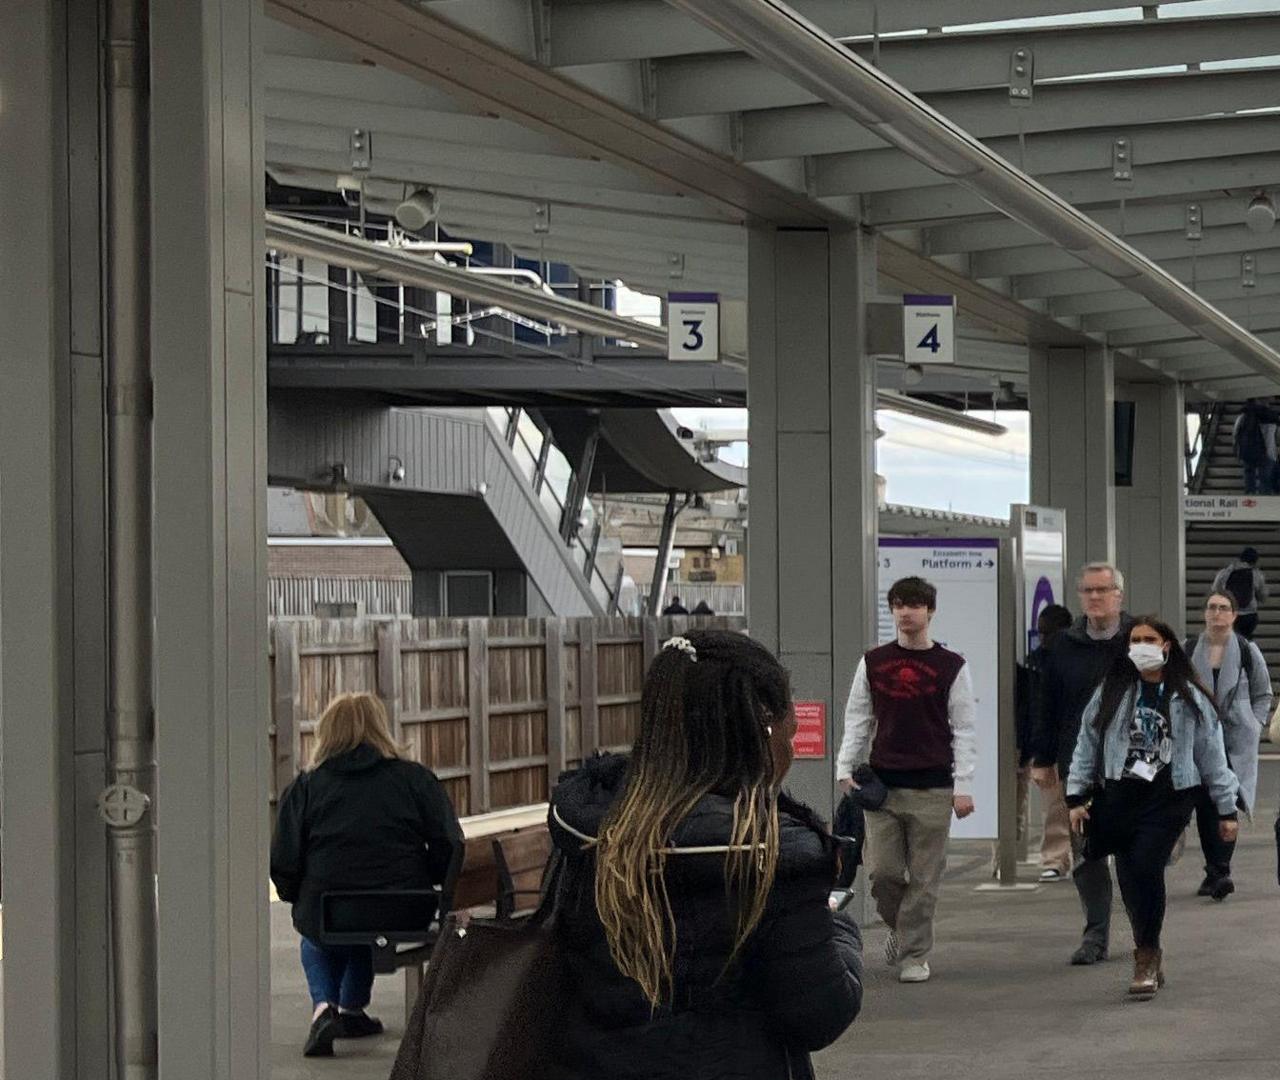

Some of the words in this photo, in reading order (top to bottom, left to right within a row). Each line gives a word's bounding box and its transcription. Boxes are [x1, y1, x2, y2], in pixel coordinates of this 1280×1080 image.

[682, 320, 703, 351] 3
[916, 322, 941, 353] 4
[1219, 498, 1238, 508] Rail
[883, 558, 891, 569] 3
[922, 559, 972, 569] Platform
[975, 559, 983, 569] 4
